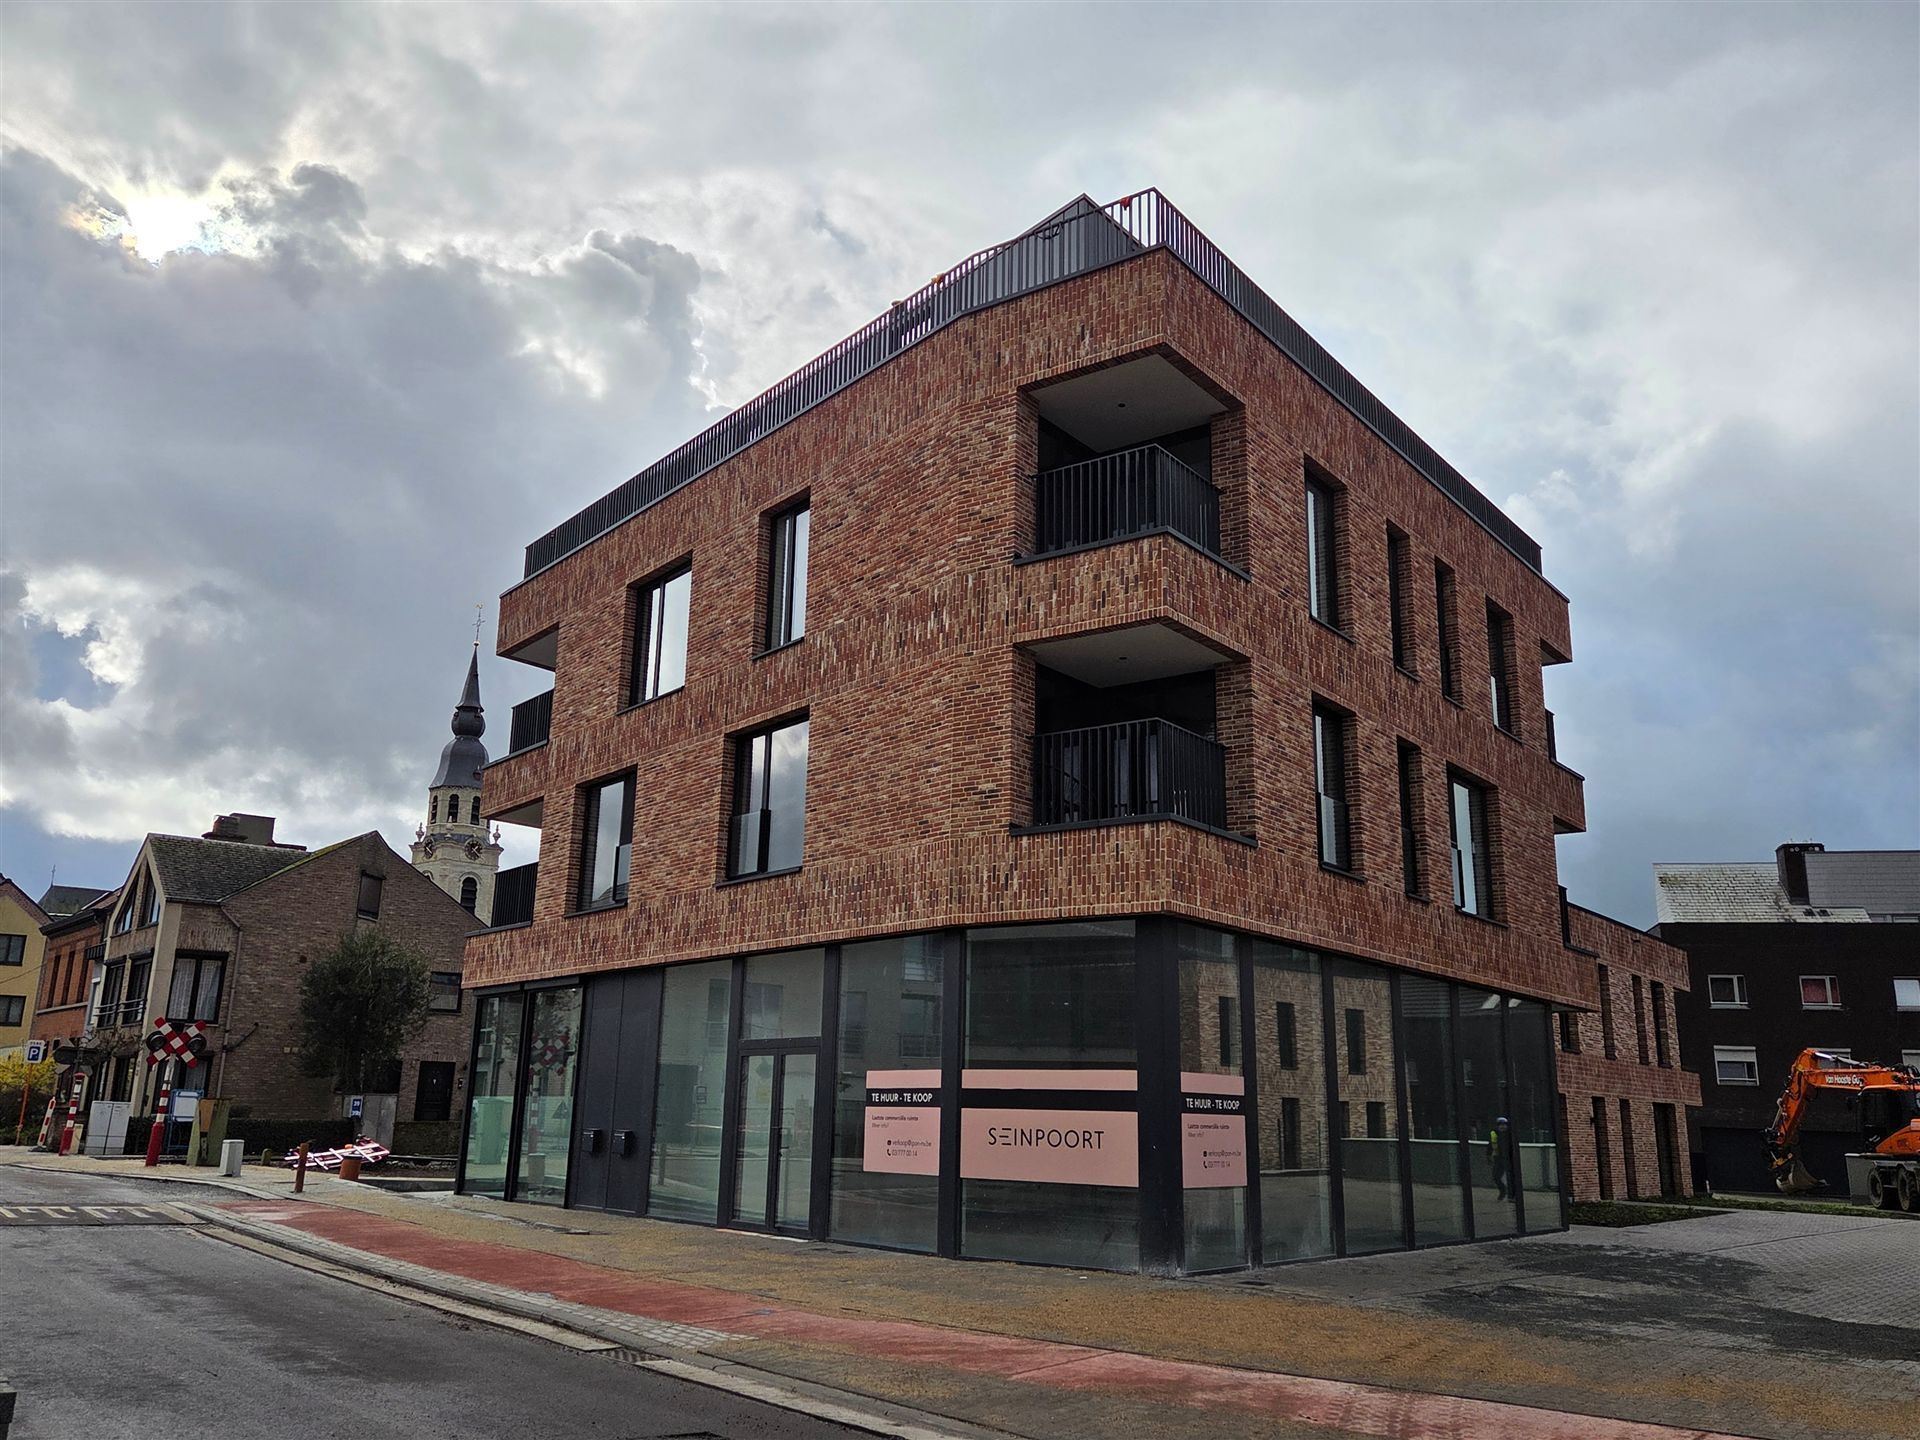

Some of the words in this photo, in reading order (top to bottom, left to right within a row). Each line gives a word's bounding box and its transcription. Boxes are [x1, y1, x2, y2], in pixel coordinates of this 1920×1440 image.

[29, 1048, 39, 1059] P
[871, 1093, 879, 1102] TE
[880, 1093, 899, 1102] HUUR
[903, 1093, 911, 1102] TE
[912, 1093, 933, 1103] KOOP
[1185, 1098, 1193, 1108] TE
[1194, 1098, 1212, 1109] HUUR
[1215, 1099, 1222, 1109] TE
[1223, 1100, 1240, 1110] KOOP
[988, 1127, 1105, 1149] SEINPOORT
